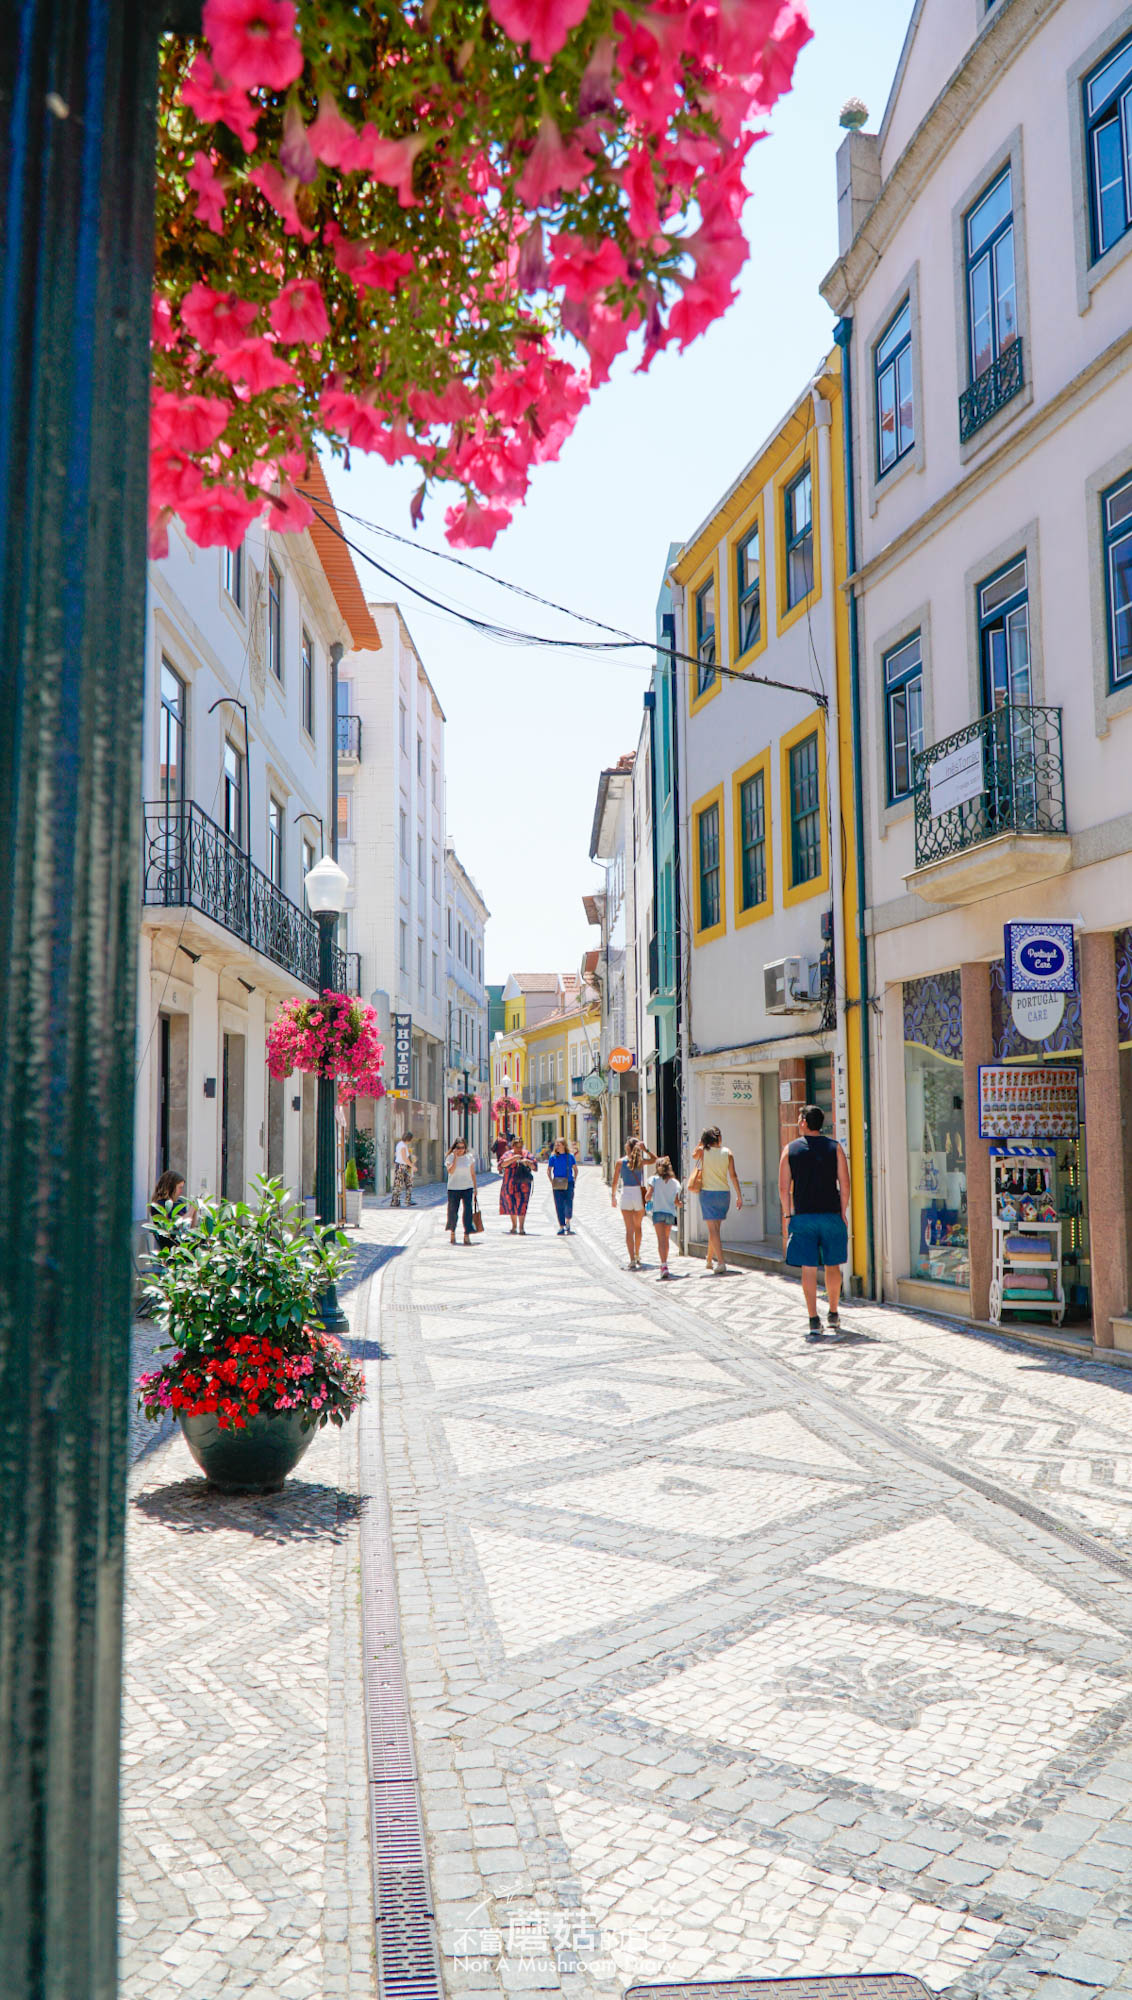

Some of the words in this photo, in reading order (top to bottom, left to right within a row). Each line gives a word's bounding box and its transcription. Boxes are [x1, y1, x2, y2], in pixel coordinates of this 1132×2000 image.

[1027, 948, 1058, 962] Portugal
[1034, 960, 1052, 969] Care
[1017, 992, 1059, 1009] PORTUGAL
[1027, 1009, 1048, 1022] CARE
[397, 1028, 410, 1086] HOTEL
[612, 1055, 631, 1065] ATM
